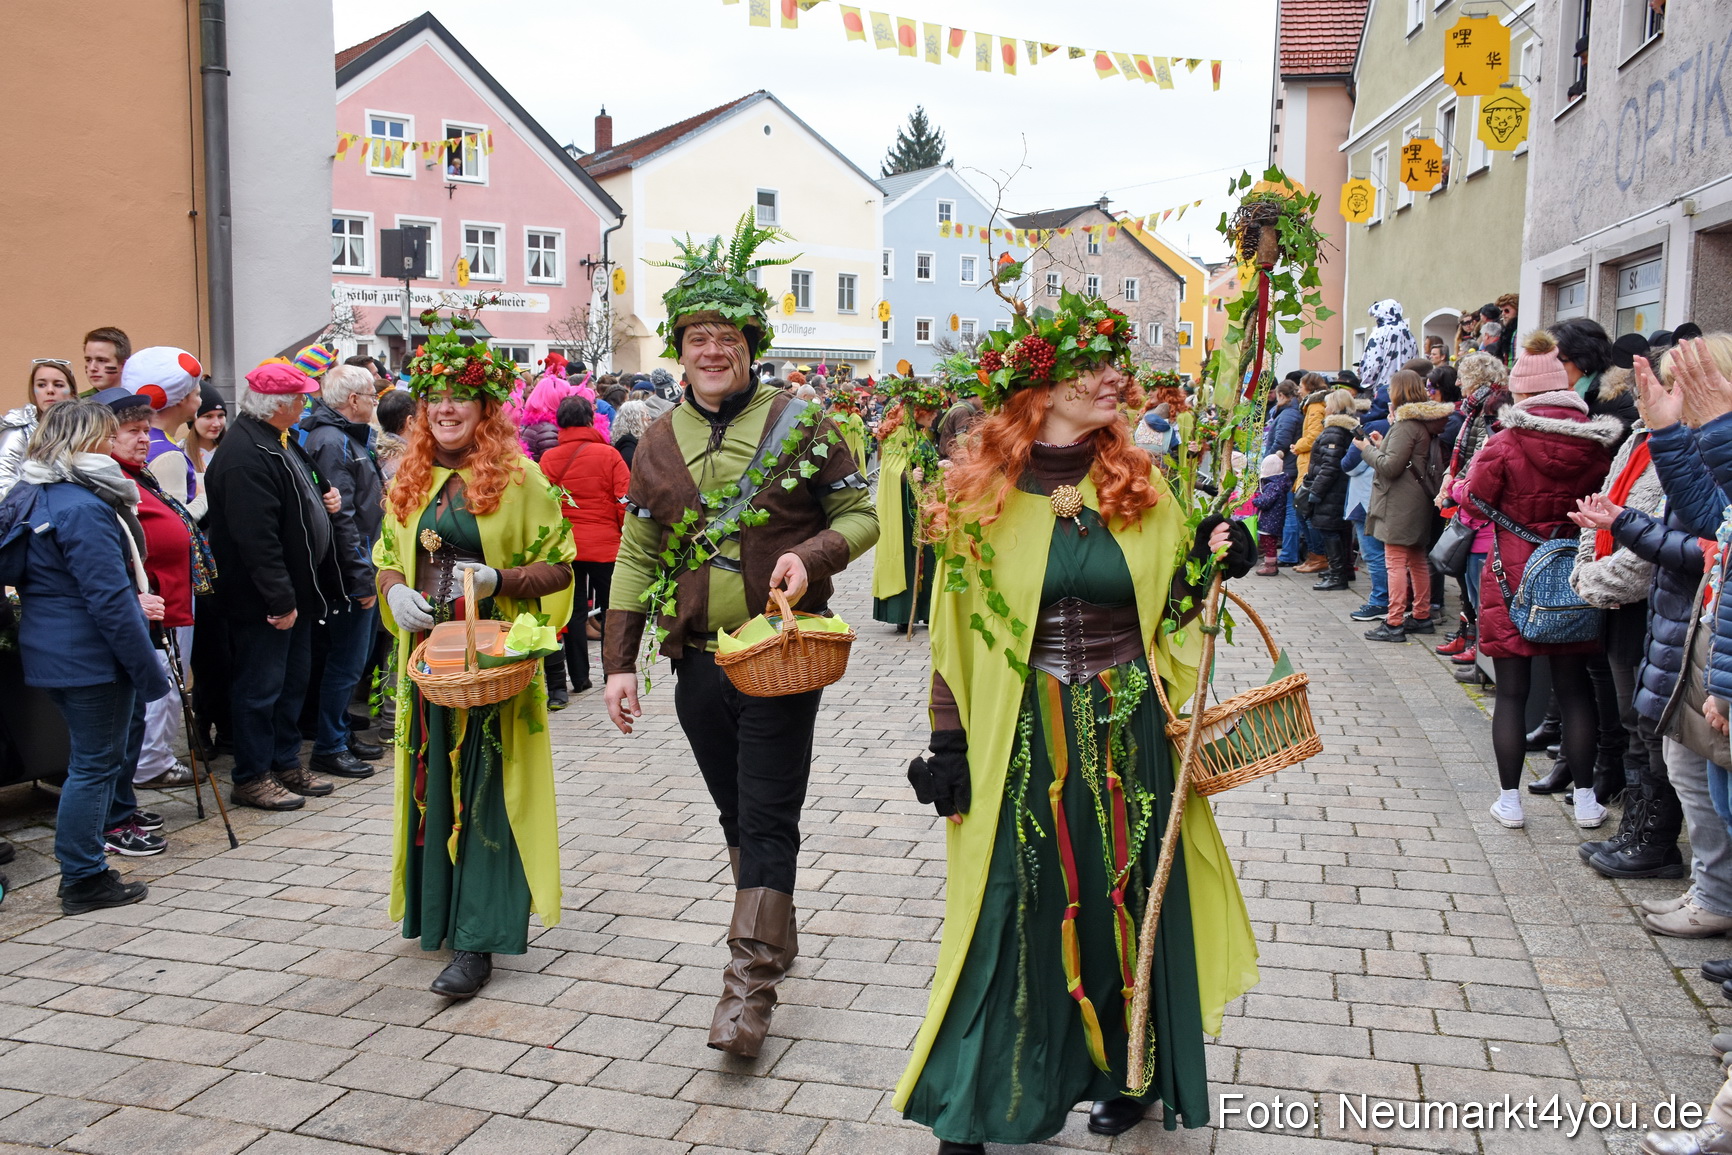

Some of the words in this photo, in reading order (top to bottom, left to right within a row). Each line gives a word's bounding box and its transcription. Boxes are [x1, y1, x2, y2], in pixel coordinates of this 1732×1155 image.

[1453, 71, 1467, 87] 人
[1615, 30, 1732, 193] OPTIK
[1405, 167, 1419, 183] 人
[781, 323, 816, 336] Döllinger
[1498, 515, 1514, 529] 1981
